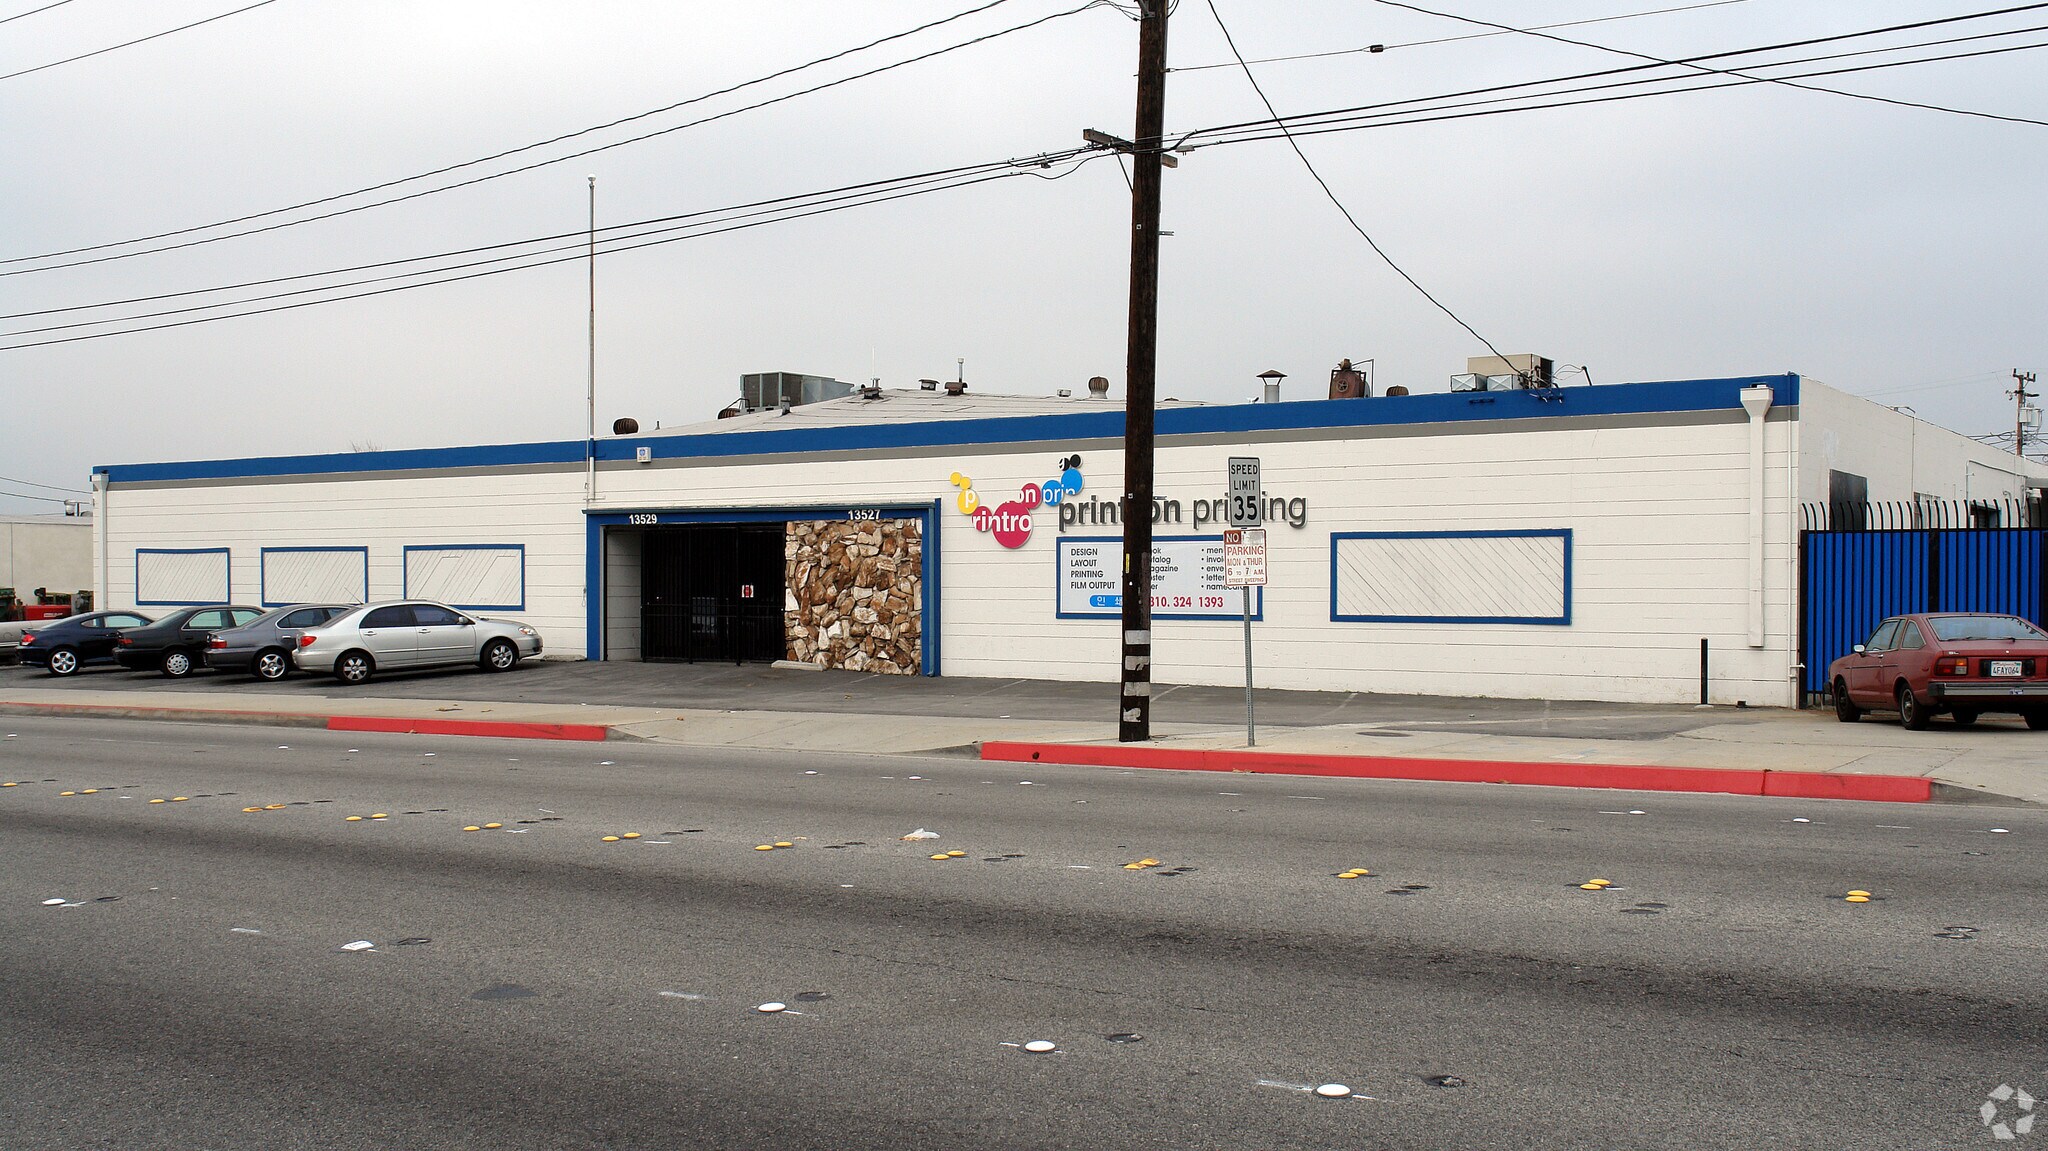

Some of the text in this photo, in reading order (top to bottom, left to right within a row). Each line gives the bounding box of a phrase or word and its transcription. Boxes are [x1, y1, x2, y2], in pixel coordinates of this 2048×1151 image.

[1230, 464, 1258, 475] SPEED
[1233, 480, 1256, 491] LIMIT
[1193, 491, 1308, 530] priing
[1233, 496, 1258, 521] 35
[628, 514, 658, 525] 13529
[848, 509, 881, 521] 13527
[1226, 533, 1239, 543] NO
[1227, 546, 1263, 555] PARKING
[1227, 558, 1241, 566] MON
[1246, 557, 1263, 566] THUR
[1151, 565, 1178, 573] agazine
[1071, 581, 1116, 589] FILM OUTPUT
[1173, 596, 1192, 607] 324
[1199, 596, 1224, 607] 1393
